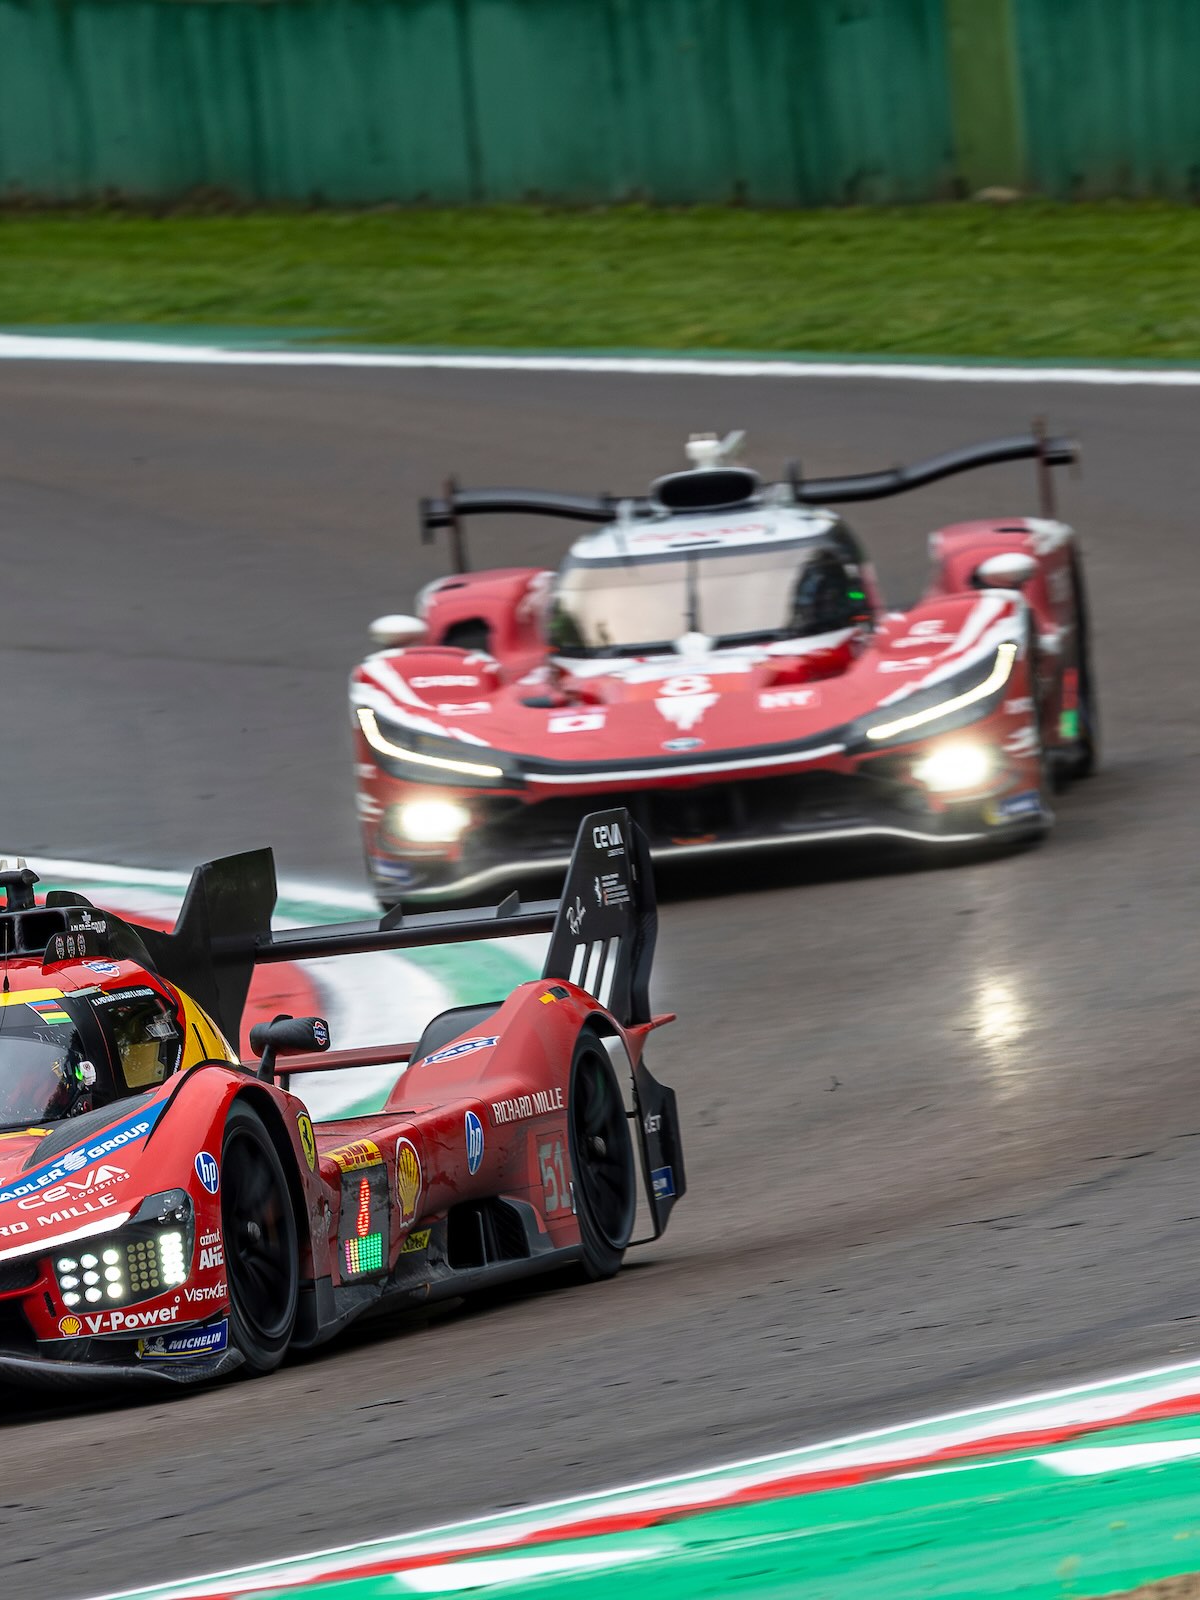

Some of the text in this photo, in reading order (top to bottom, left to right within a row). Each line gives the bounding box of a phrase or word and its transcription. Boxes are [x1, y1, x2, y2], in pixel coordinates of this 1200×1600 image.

[658, 675, 713, 697] 8
[491, 1087, 564, 1124] RICHARD MILLE
[87, 1121, 150, 1159] GROUP
[467, 1113, 482, 1173] hp
[71, 1173, 131, 1201] LOGISTICS
[198, 1153, 217, 1193] hp
[538, 1140, 572, 1213] 51
[36, 1192, 118, 1227] MILLE
[200, 1229, 221, 1246] azimut
[184, 1280, 228, 1302] VISTAJET
[85, 1305, 180, 1334] V-Power
[168, 1332, 222, 1350] MICHELIN
